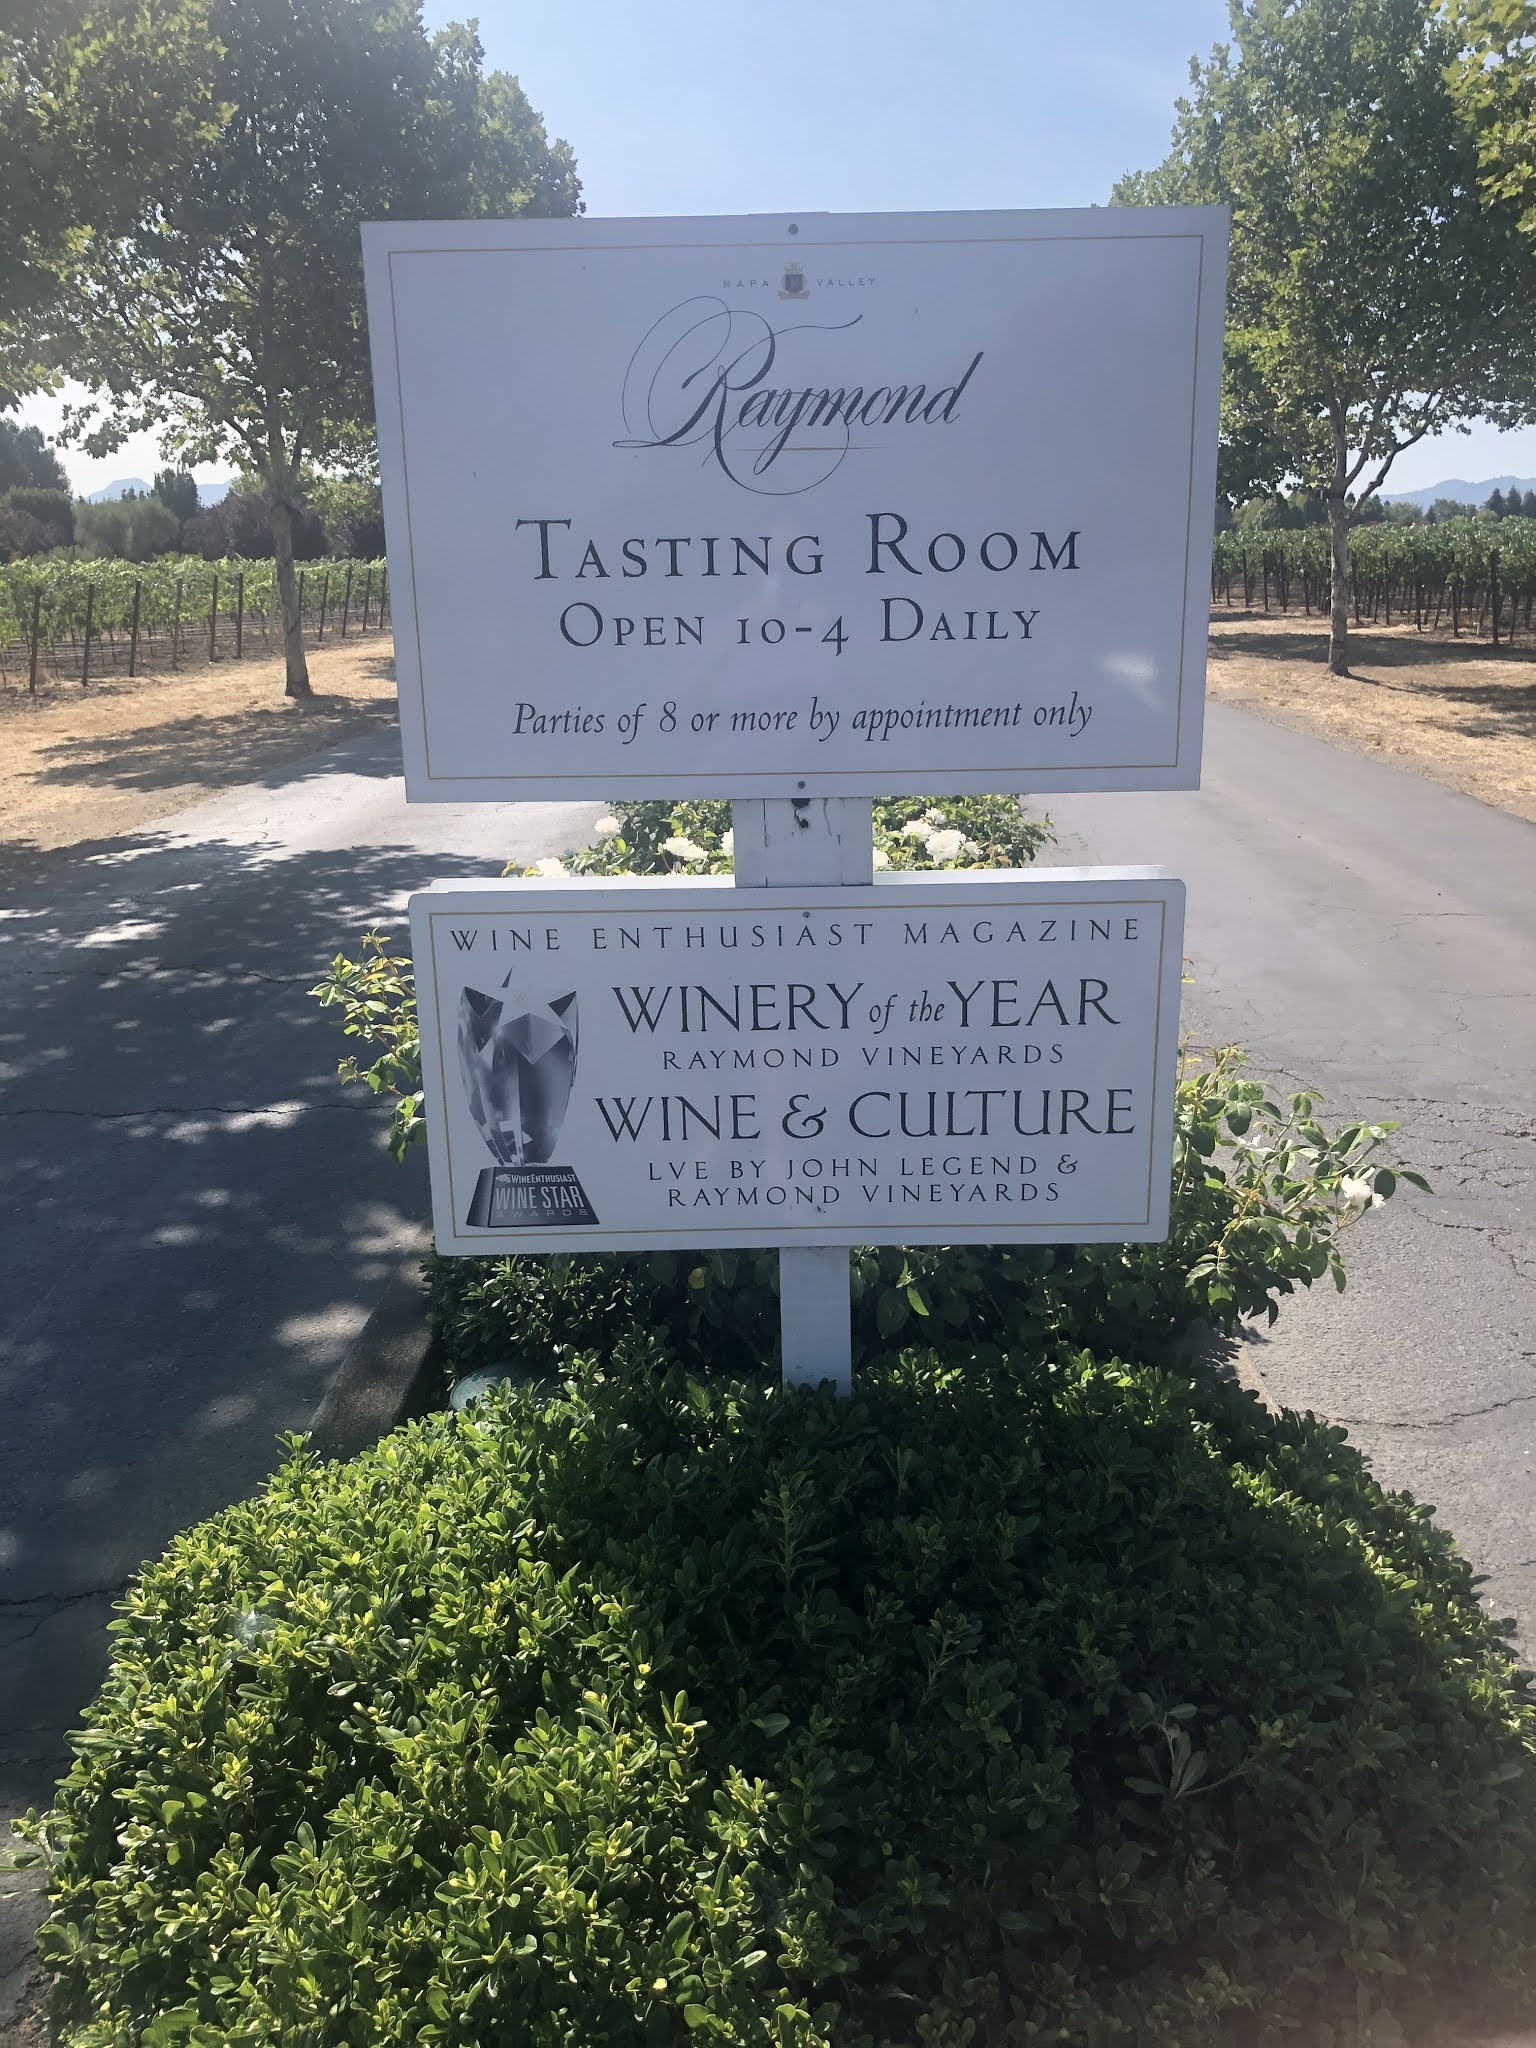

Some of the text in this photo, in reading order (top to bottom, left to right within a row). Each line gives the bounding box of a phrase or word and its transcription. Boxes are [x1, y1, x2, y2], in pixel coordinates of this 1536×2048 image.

[723, 277, 876, 288] NAPA VALLEY
[612, 295, 985, 496] Raymond
[515, 512, 1082, 580] TASTING ROOM
[559, 602, 704, 647] OPEN
[880, 597, 1041, 643] DAILY
[512, 691, 1093, 745] Parties of 8 or more by appointment only
[450, 918, 1139, 951] WINE ENTHUSIAST MAGAZINE
[611, 979, 1121, 1035] WINERY of the YEAR
[663, 1043, 1064, 1070] RAYMOND VINEYARDS
[594, 1088, 1135, 1143] WINE & CULTURE
[648, 1154, 1079, 1182] LVE BY JOHN LEGEND &
[495, 1186, 584, 1209] WINE STAR
[667, 1183, 1060, 1207] RAYMOND VINEYARDS
[496, 1209, 588, 1217] AWARDS
